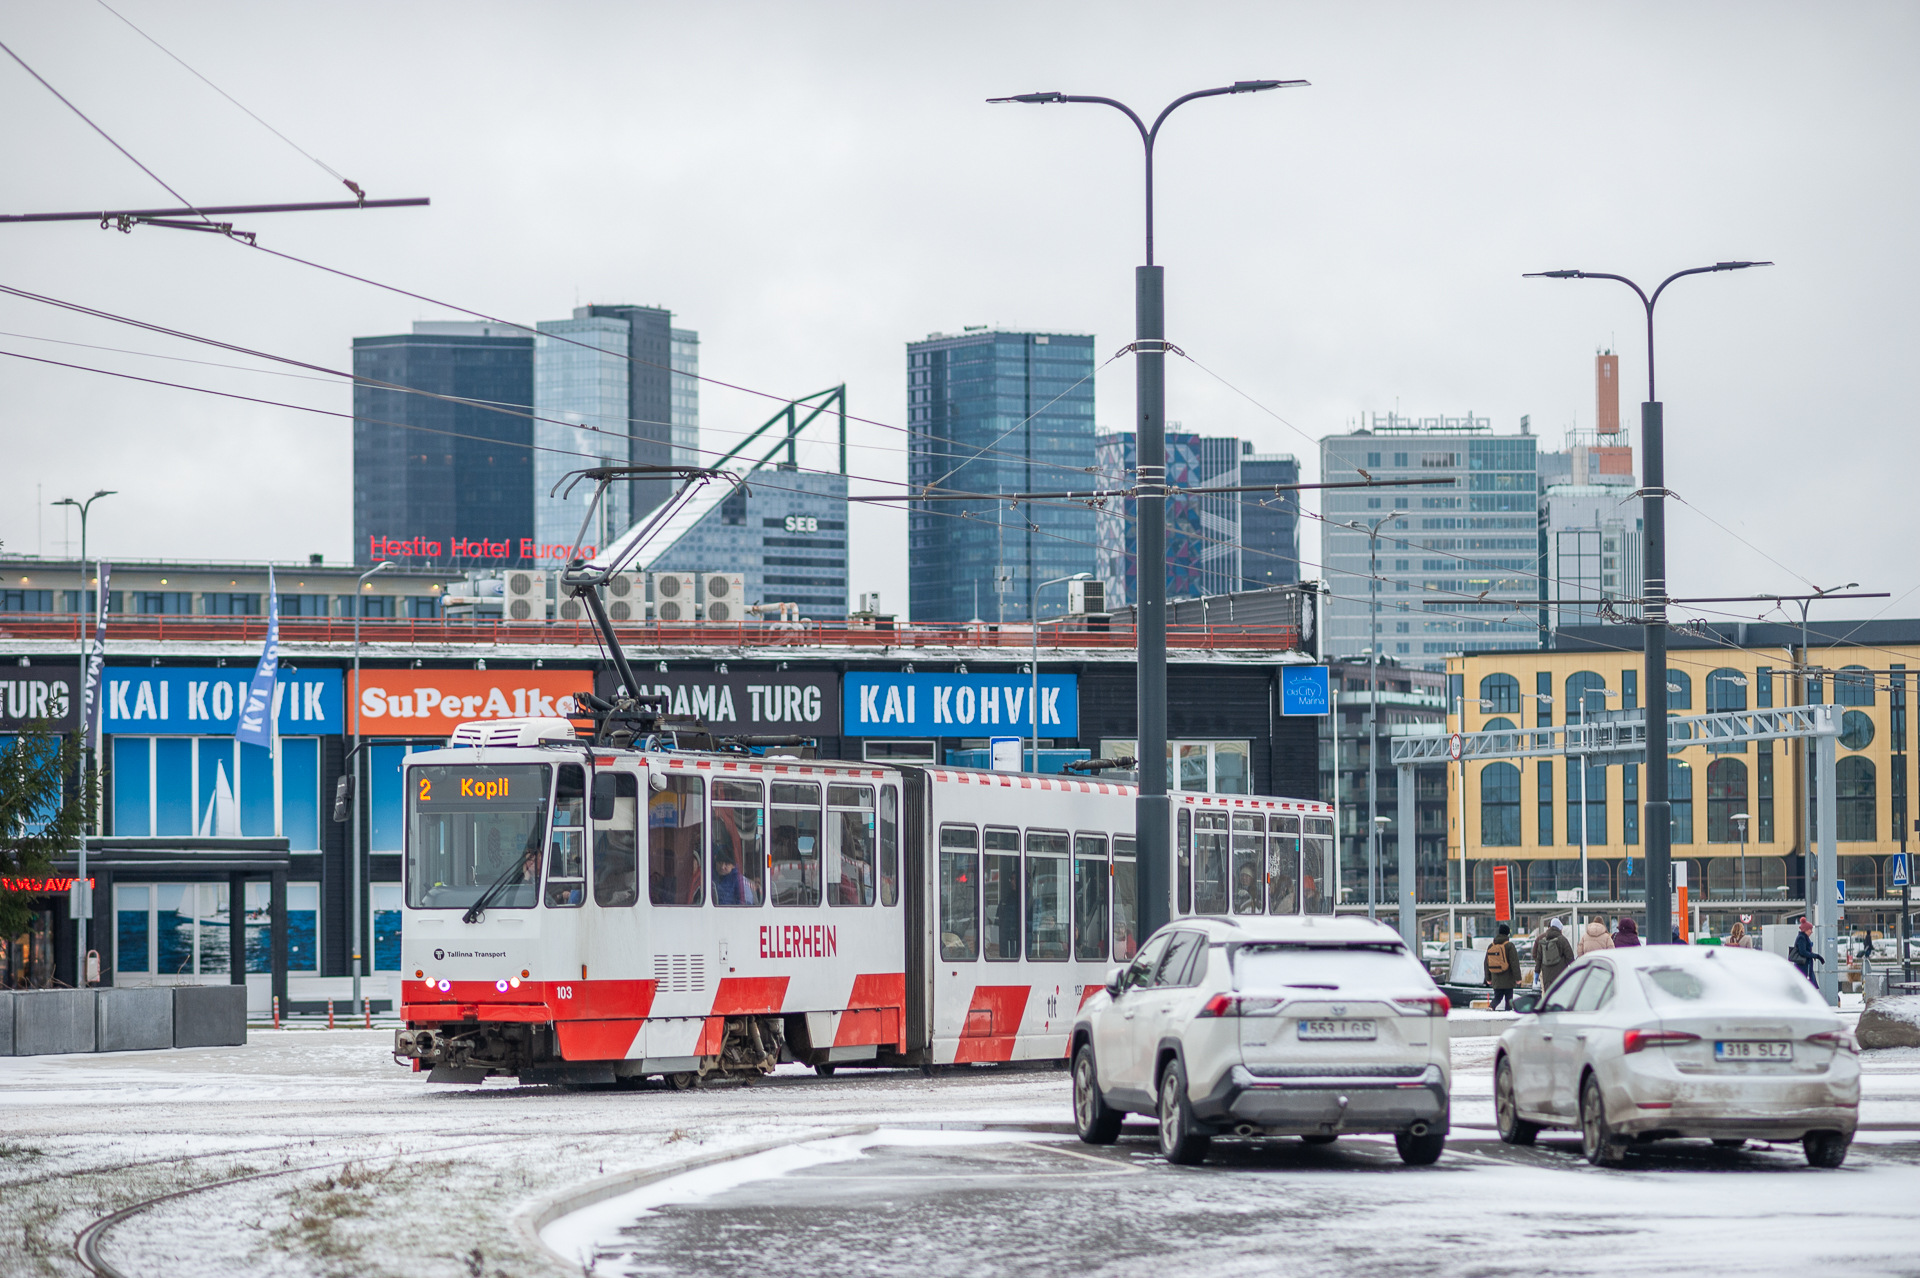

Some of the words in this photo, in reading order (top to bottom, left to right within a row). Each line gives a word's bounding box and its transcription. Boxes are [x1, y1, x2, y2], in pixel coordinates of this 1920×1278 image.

[786, 516, 818, 532] SEB
[370, 535, 442, 561] Hestia
[451, 537, 510, 558] Hotel
[110, 680, 169, 720] KAI
[747, 685, 822, 722] TURG
[860, 685, 915, 723] KAI
[1299, 696, 1325, 705] Marina
[420, 778, 432, 801] 2
[461, 777, 509, 800] Kopli
[760, 925, 837, 959] ELLERHEIN
[447, 950, 473, 958] Tallinna
[475, 950, 507, 959] Transport
[556, 986, 572, 999] 103
[1727, 1043, 1751, 1057] 318
[1758, 1043, 1788, 1057] SLZ
